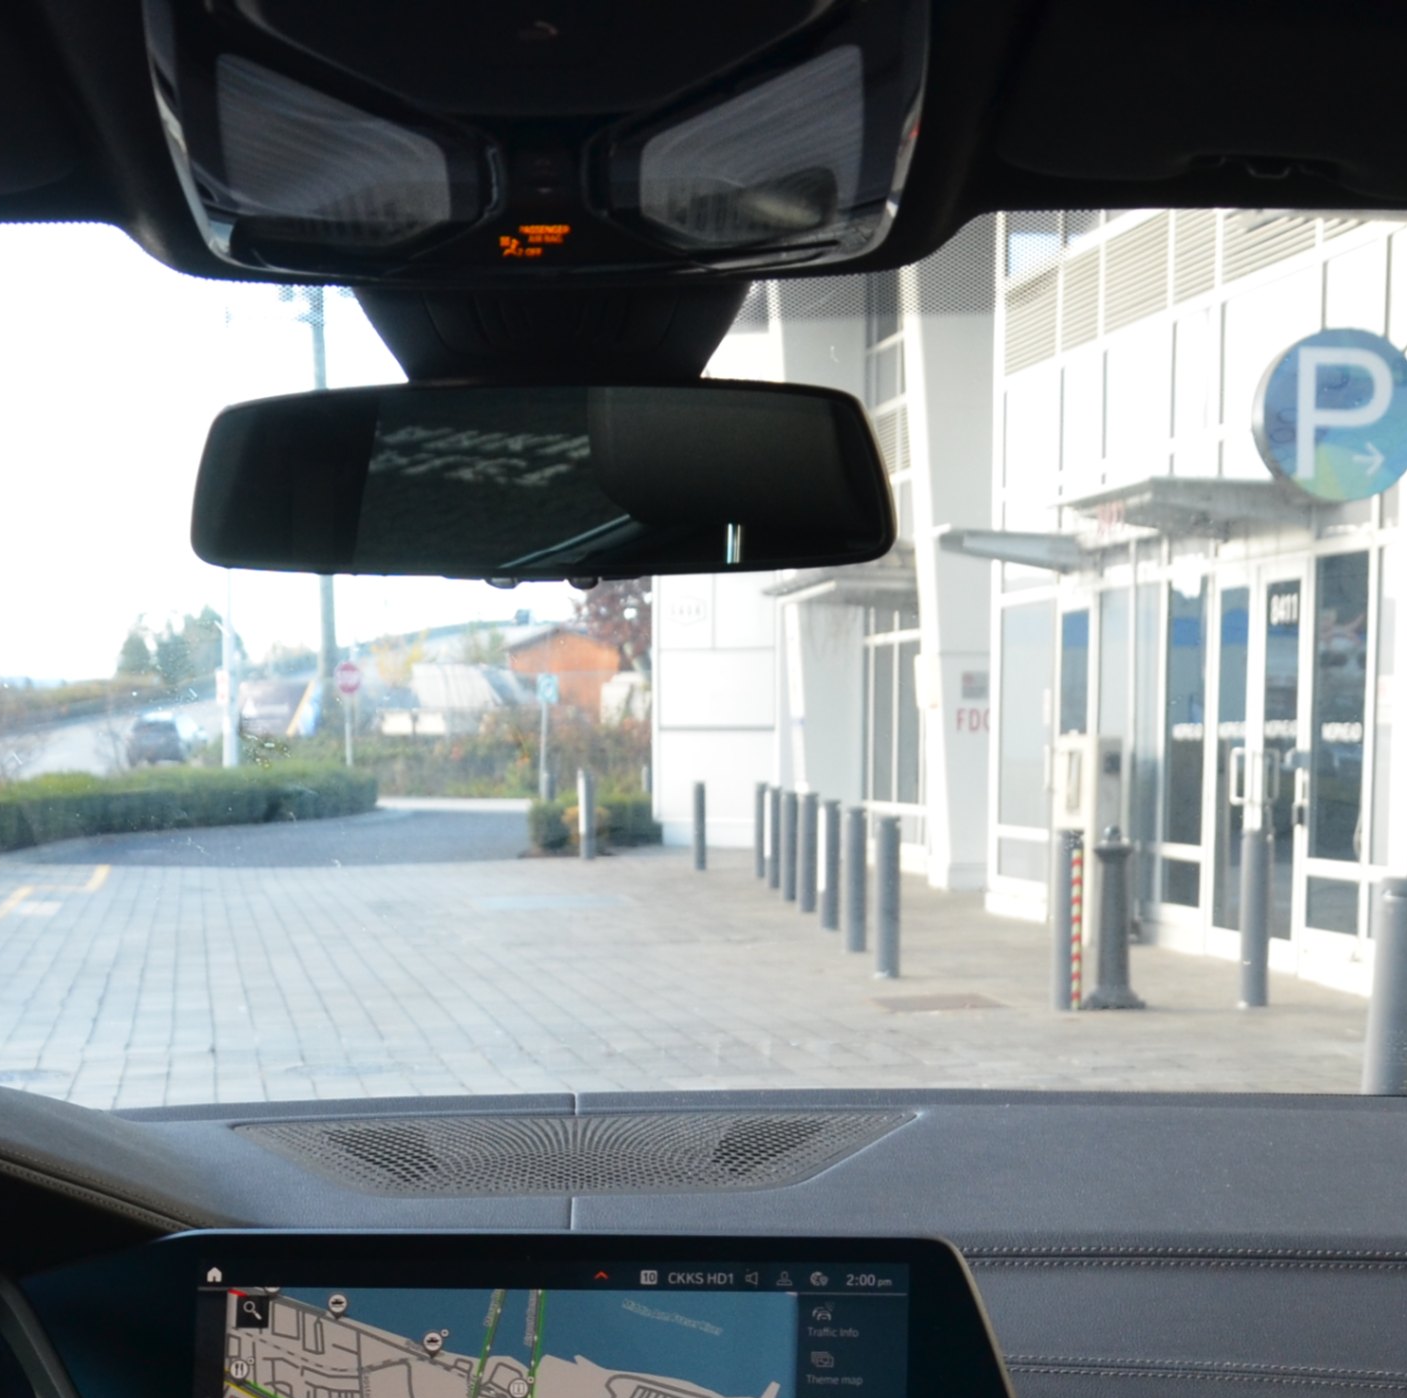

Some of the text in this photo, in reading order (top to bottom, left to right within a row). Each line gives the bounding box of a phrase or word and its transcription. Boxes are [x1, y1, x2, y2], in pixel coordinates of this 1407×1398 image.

[1295, 346, 1394, 480] P
[668, 1272, 704, 1285] CKKS
[707, 1272, 734, 1285] HD1
[846, 1274, 893, 1287] 2:00 pm
[808, 1327, 838, 1337] Traffic
[807, 1374, 863, 1387] Theme map
